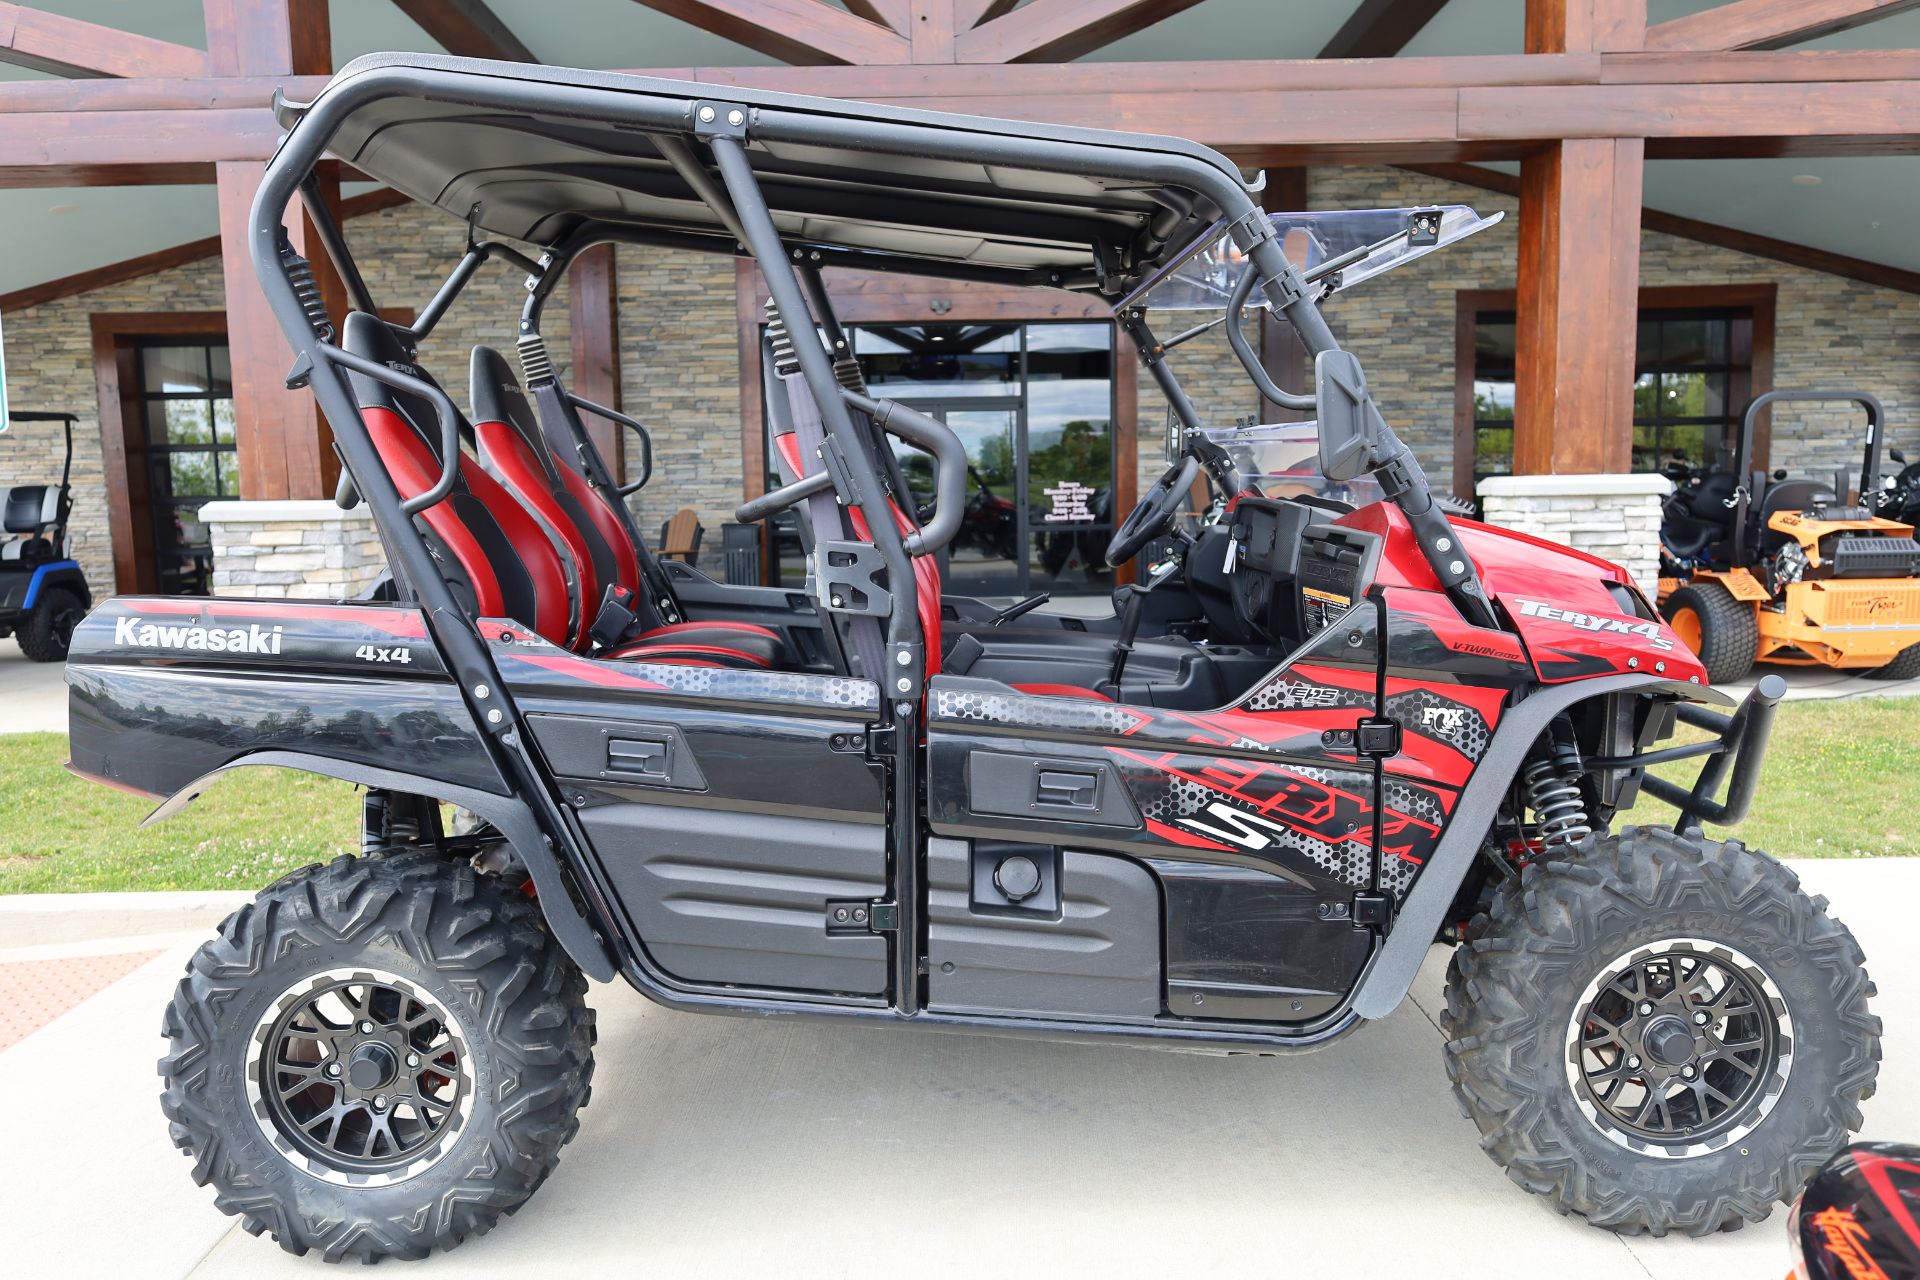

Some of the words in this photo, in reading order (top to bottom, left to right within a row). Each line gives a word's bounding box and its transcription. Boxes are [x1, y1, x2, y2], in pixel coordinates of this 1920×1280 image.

[114, 616, 282, 655] Kawasaki
[355, 644, 412, 664] 4x4
[1453, 642, 1495, 656] V-TWIN
[1421, 706, 1465, 736] FOX
